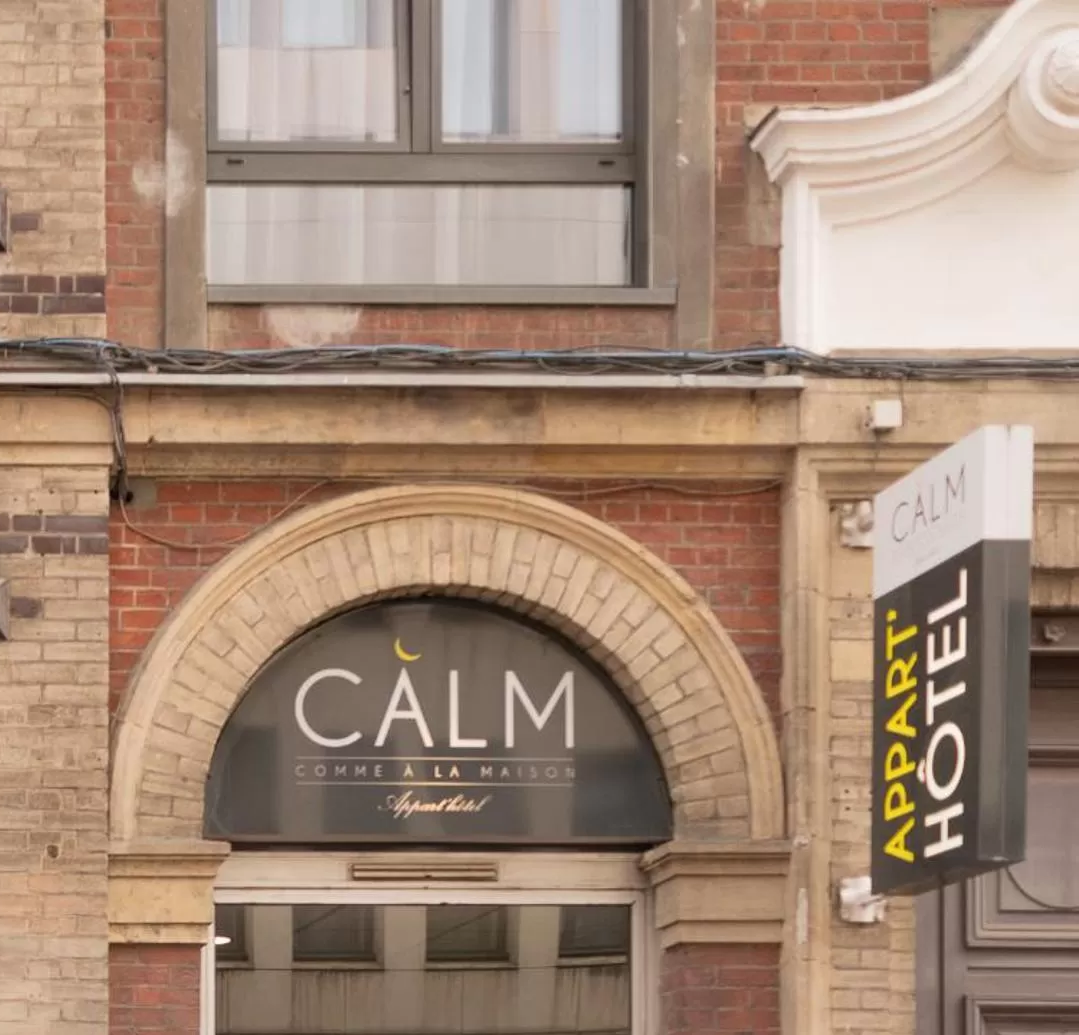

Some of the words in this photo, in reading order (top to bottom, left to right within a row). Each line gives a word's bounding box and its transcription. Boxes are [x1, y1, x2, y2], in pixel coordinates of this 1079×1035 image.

[294, 764, 384, 778] COMME
[434, 764, 461, 779] LA
[480, 764, 576, 779] MAISON
[917, 567, 968, 859] HÔTEL
